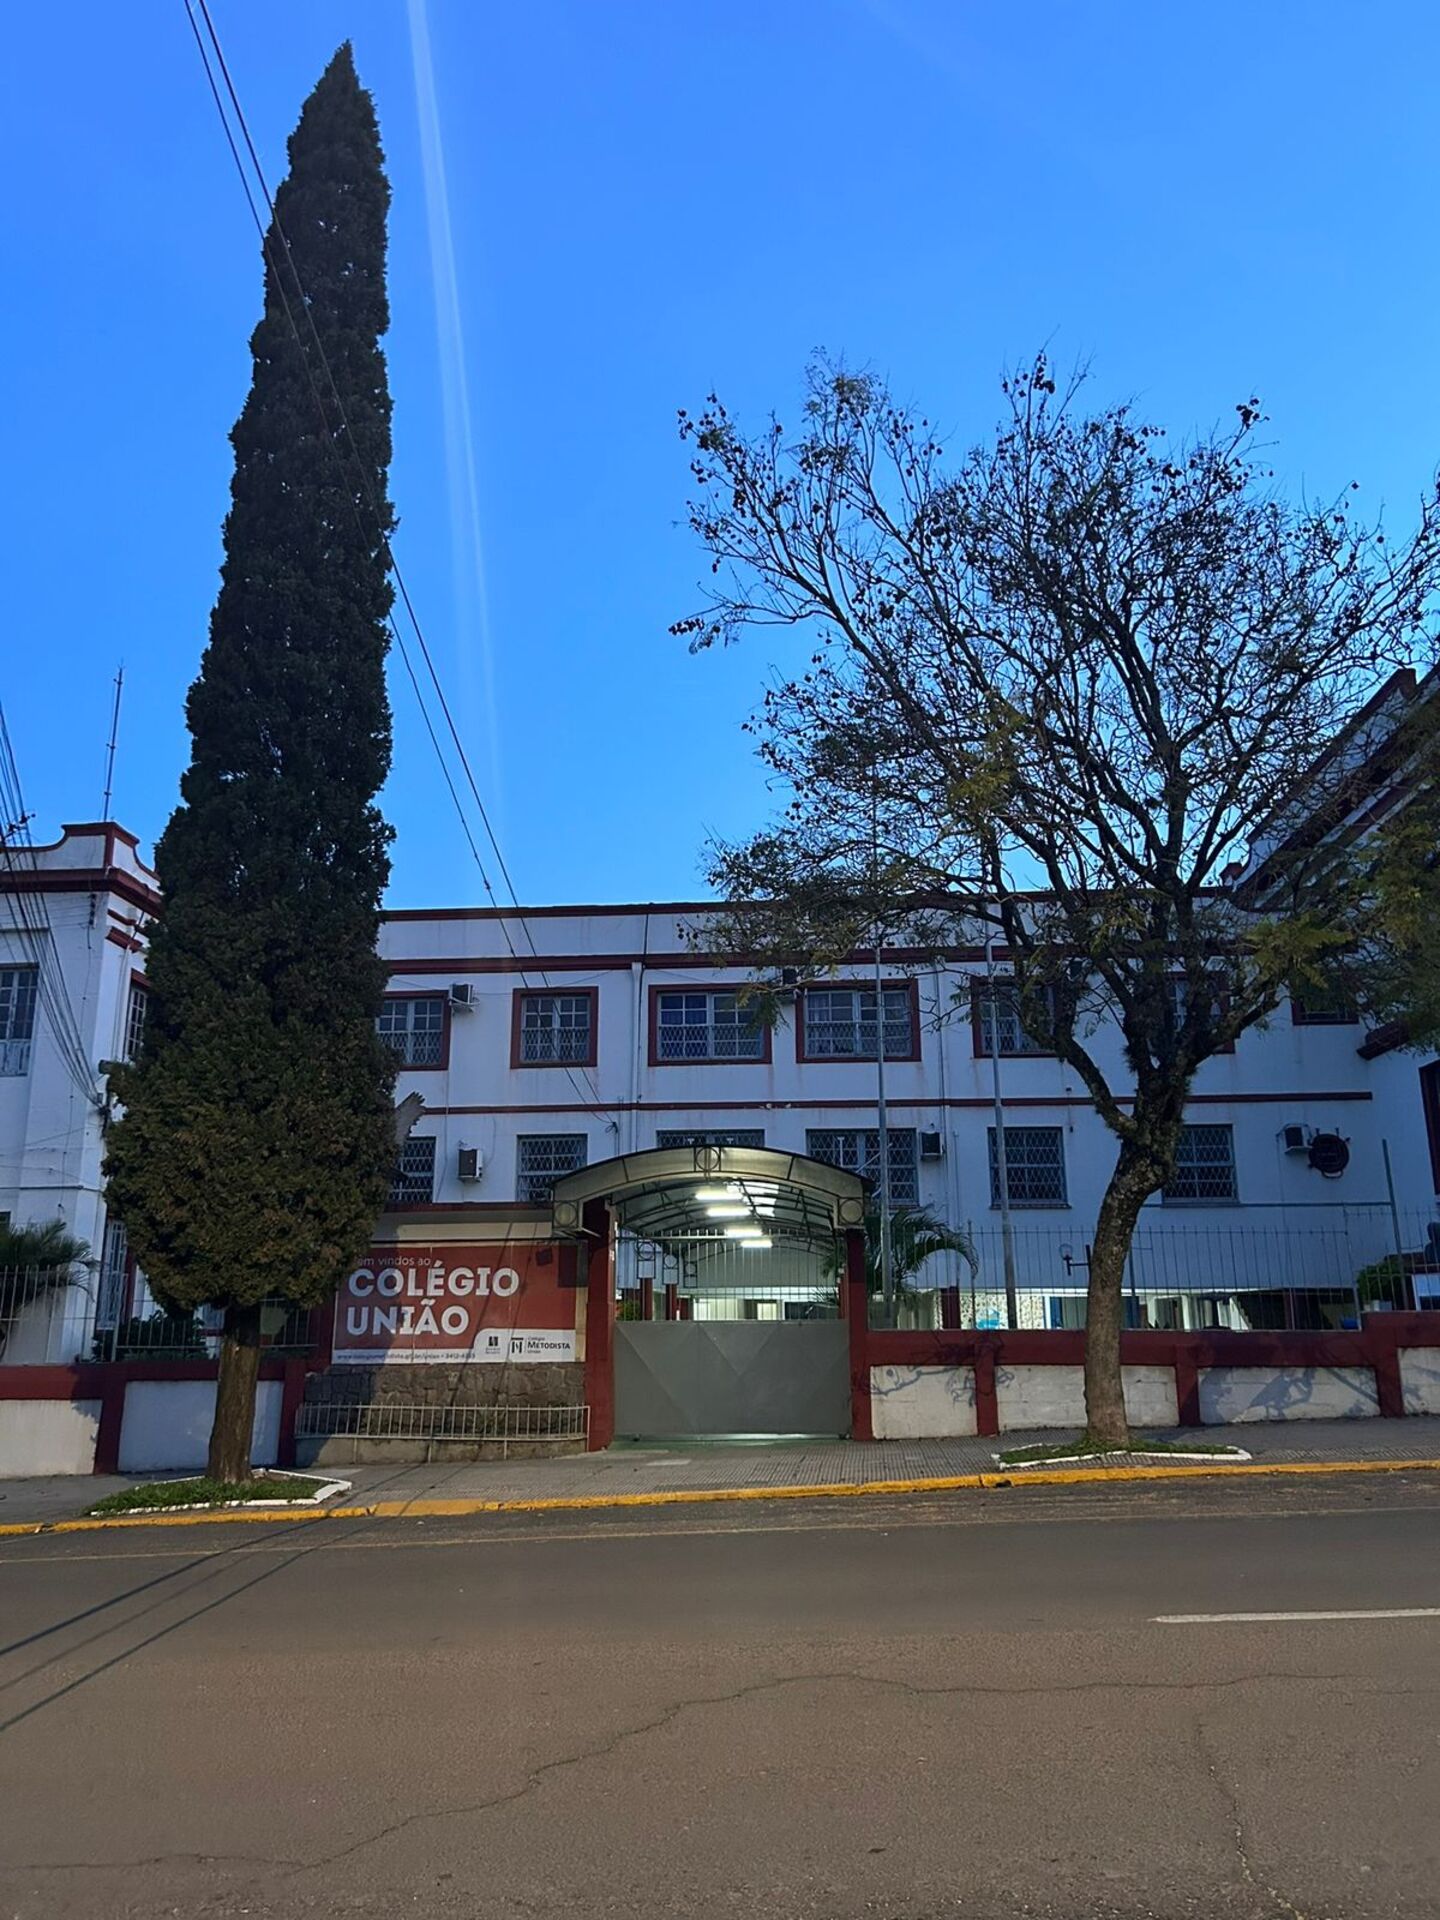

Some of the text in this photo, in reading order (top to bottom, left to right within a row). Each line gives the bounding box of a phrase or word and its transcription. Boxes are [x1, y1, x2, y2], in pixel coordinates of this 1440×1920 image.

[348, 1260, 519, 1297] COLÉGIO
[378, 1255, 415, 1266] vindos
[418, 1257, 431, 1266] ao
[346, 1298, 470, 1335] UNIÃO
